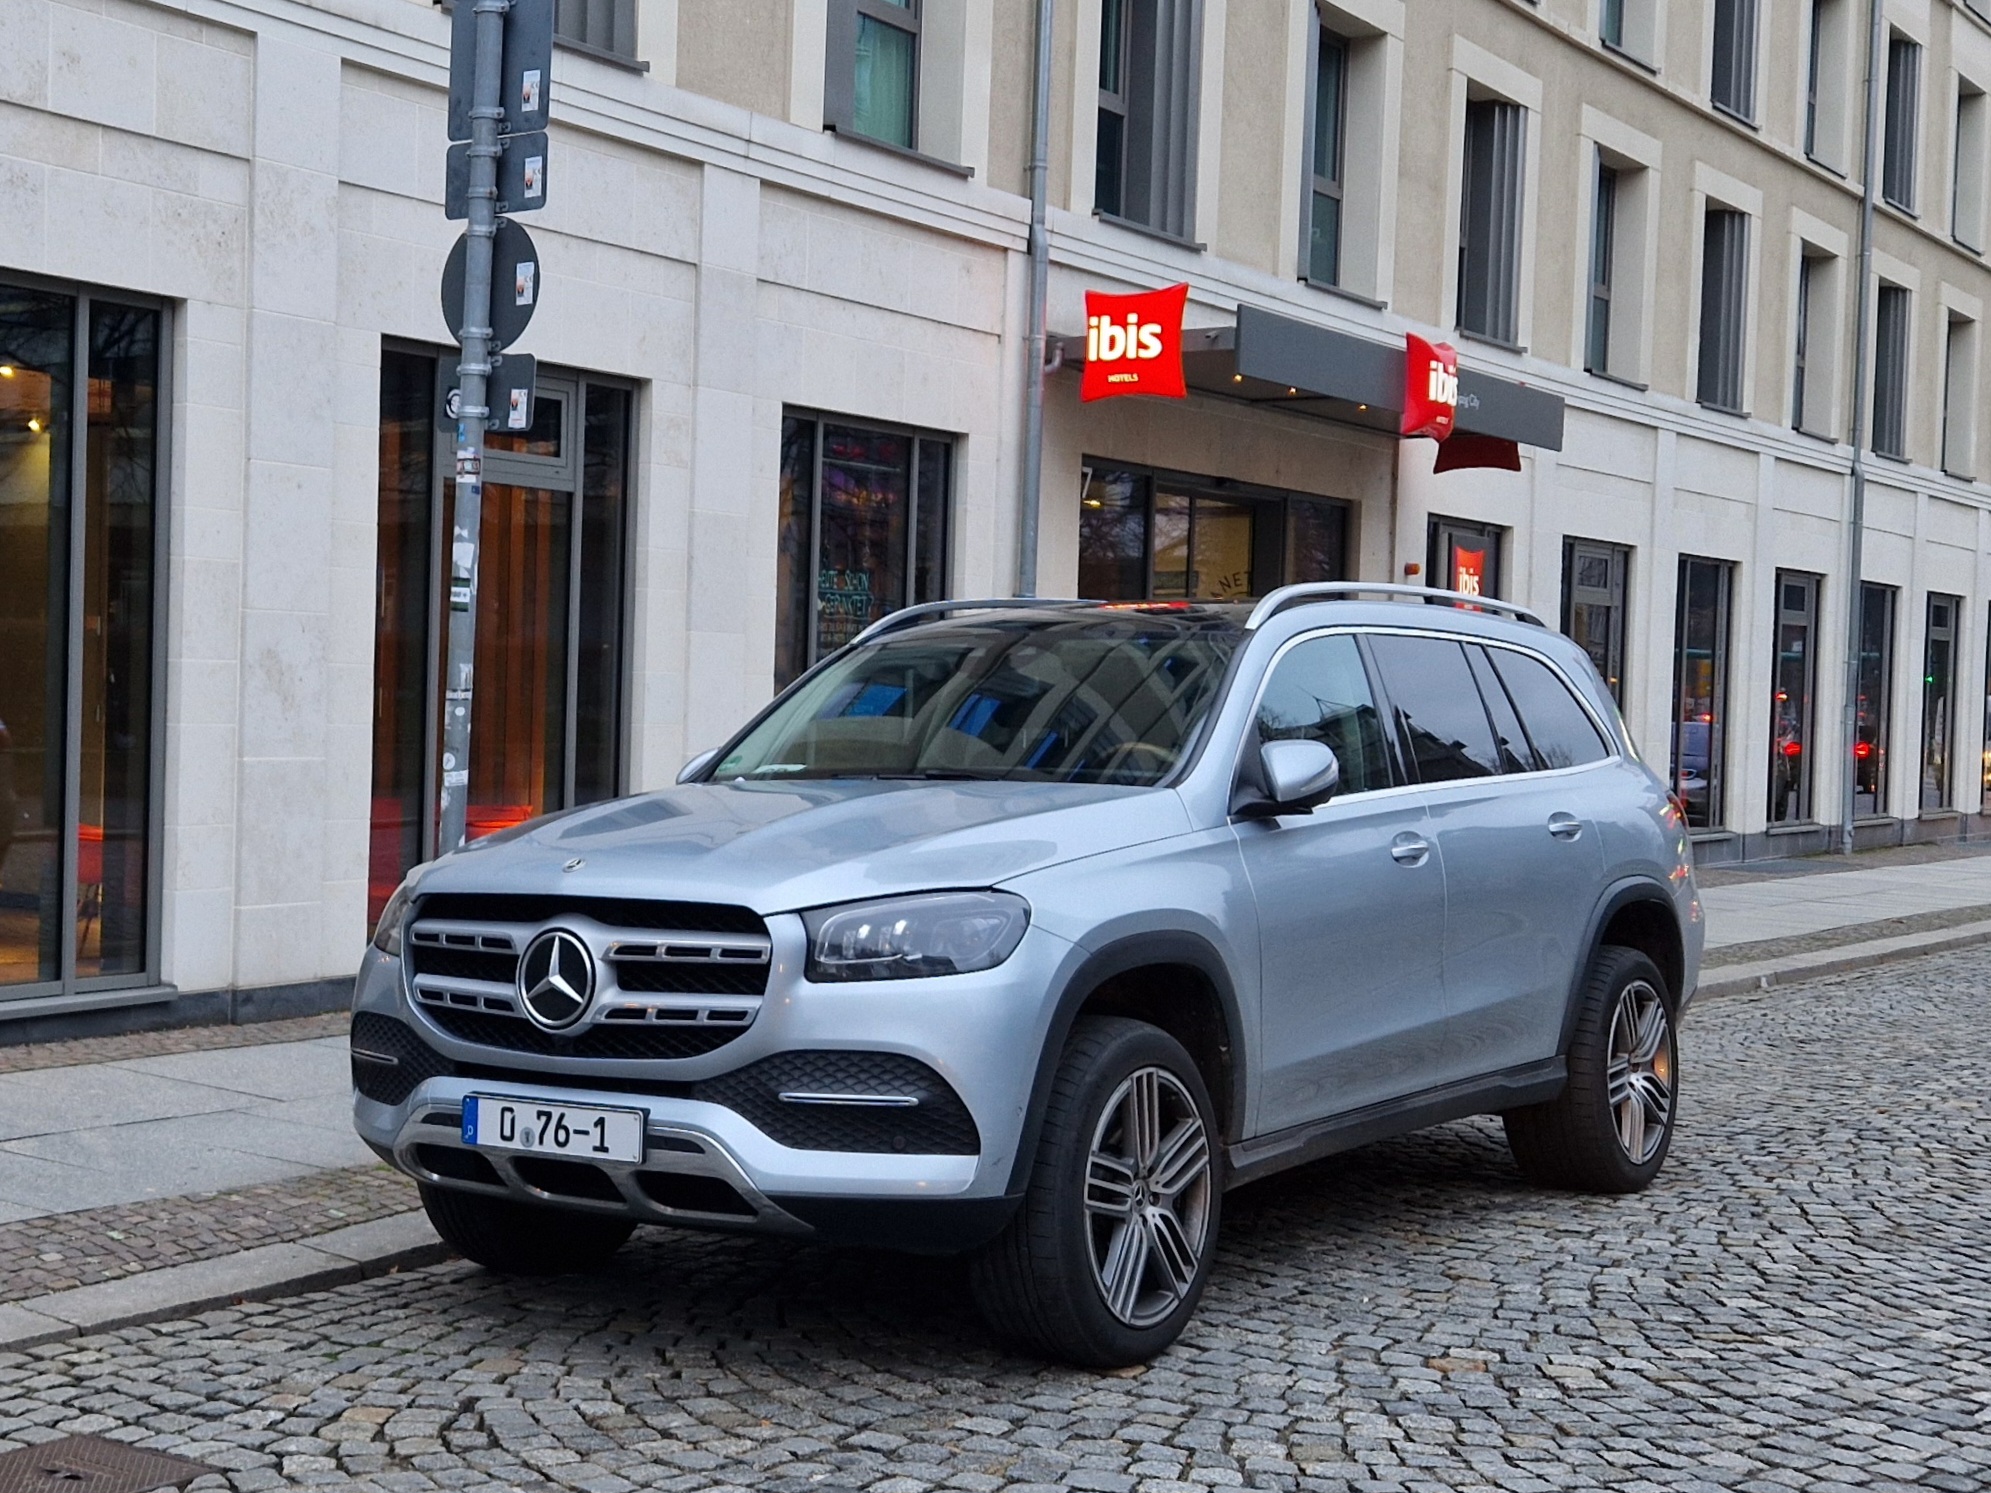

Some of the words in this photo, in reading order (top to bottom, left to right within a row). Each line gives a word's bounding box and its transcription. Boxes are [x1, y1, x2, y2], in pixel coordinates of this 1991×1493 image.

[1087, 312, 1163, 362] ibis
[1107, 372, 1139, 383] HOTELS
[1457, 566, 1480, 596] ibis
[536, 1109, 610, 1153] 76-1
